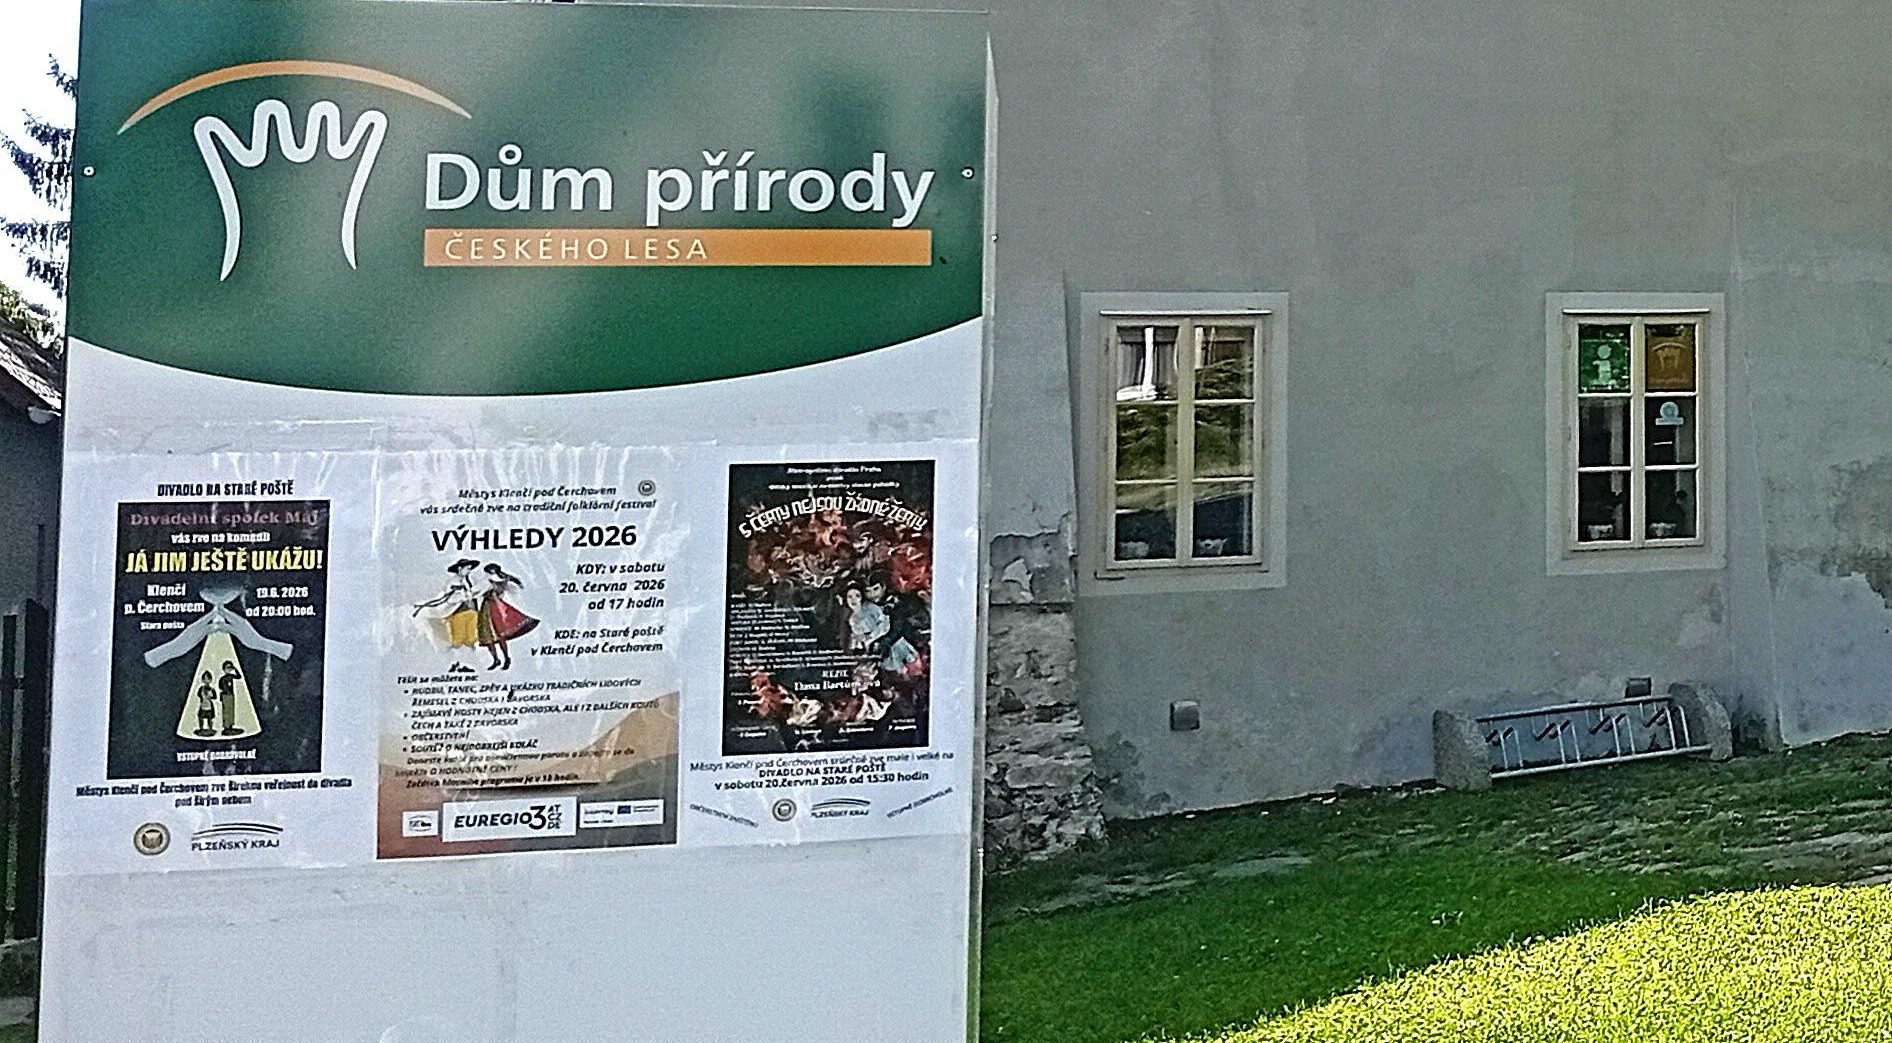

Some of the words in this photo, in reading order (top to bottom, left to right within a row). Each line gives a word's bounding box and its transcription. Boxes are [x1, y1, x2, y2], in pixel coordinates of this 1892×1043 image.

[426, 144, 613, 211] Dům
[646, 150, 936, 228] přírody
[444, 232, 609, 261] ČESKÉHO
[625, 237, 708, 260] LESA
[157, 483, 203, 496] DIVADLO
[206, 483, 220, 496] NA
[224, 480, 257, 496] STARÉ
[261, 479, 294, 495] POŠTĚ
[533, 488, 556, 500] pod
[557, 485, 617, 496] Čerchovem
[420, 504, 438, 514] vás
[506, 504, 521, 512] na
[614, 499, 658, 512] festival
[738, 522, 752, 539] S
[746, 504, 791, 531] ČERTY
[791, 496, 843, 517] NEJSOU
[844, 491, 891, 517] ŽÁDNÉ
[887, 498, 928, 531] ŽERTY
[431, 524, 565, 551] VÝHLEDY
[572, 525, 637, 548] 2026
[125, 547, 148, 573] JÁ
[151, 551, 186, 572] JIM
[191, 547, 247, 572] JEŠTĚ
[251, 546, 324, 571] UKÁŽU!
[576, 563, 606, 574] KDY:
[609, 564, 617, 573] v
[619, 562, 666, 574] sobotu
[147, 583, 186, 597] Klenčí
[282, 586, 309, 598] 2026
[559, 582, 579, 593] 20.
[583, 581, 628, 592] června
[634, 579, 666, 591] 2026
[138, 600, 205, 614] Čerchovem
[245, 607, 260, 617] od
[262, 606, 291, 617] 20:00
[588, 598, 606, 610] od
[609, 598, 624, 609] 17
[626, 597, 665, 609] hodin
[554, 630, 581, 639] KDE:
[582, 630, 597, 638] na
[540, 644, 576, 655] Klenčí
[575, 644, 599, 657] pod
[601, 642, 663, 653] Čerchovem
[759, 767, 803, 778] DIVADLO
[805, 766, 821, 776] NA
[714, 782, 722, 790] v
[724, 779, 763, 790] sobotu
[821, 776, 847, 786] 2026
[849, 774, 864, 784] od
[897, 771, 929, 781] hodin
[192, 838, 249, 851] PLZEŇSKÝ
[251, 839, 280, 849] KRAJ
